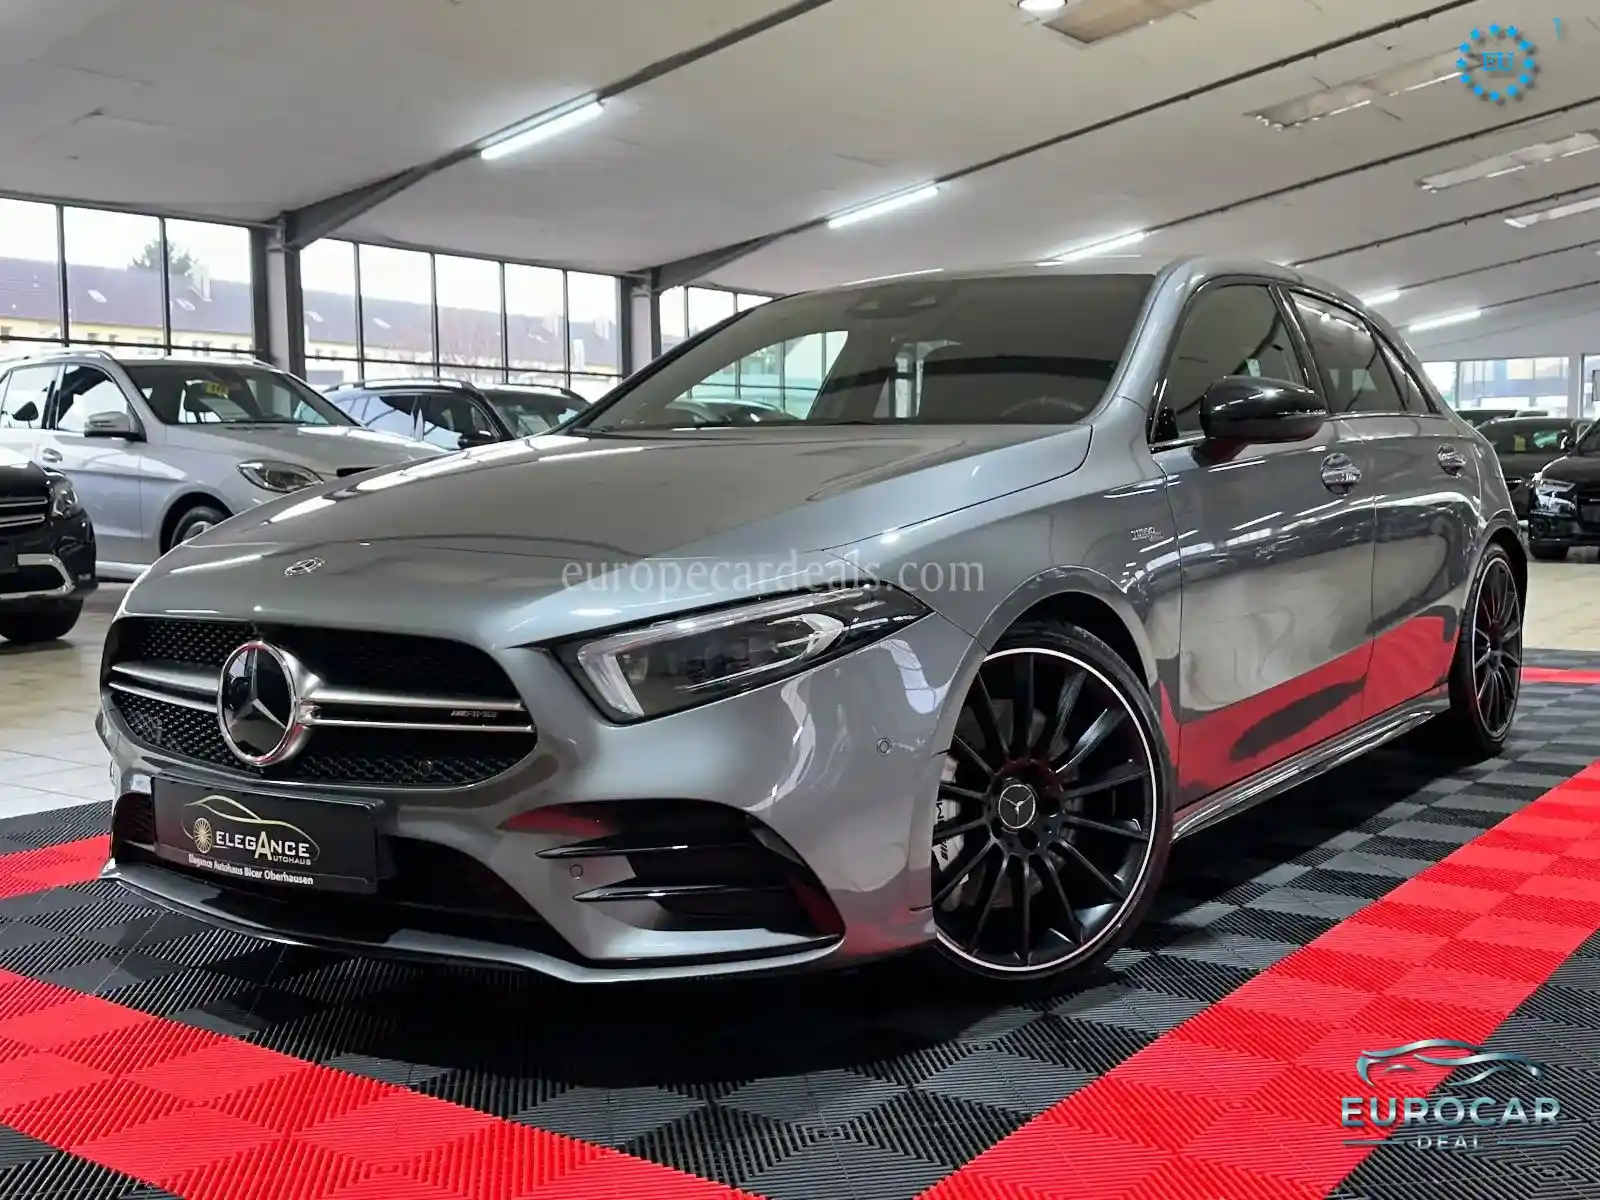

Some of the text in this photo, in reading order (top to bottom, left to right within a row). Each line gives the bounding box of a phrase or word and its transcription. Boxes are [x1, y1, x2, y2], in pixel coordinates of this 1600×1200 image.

[215, 830, 311, 861] ELEGANCE
[188, 853, 213, 869] Elegance
[213, 860, 244, 876] Autohaus
[264, 870, 314, 885] Oberhausen
